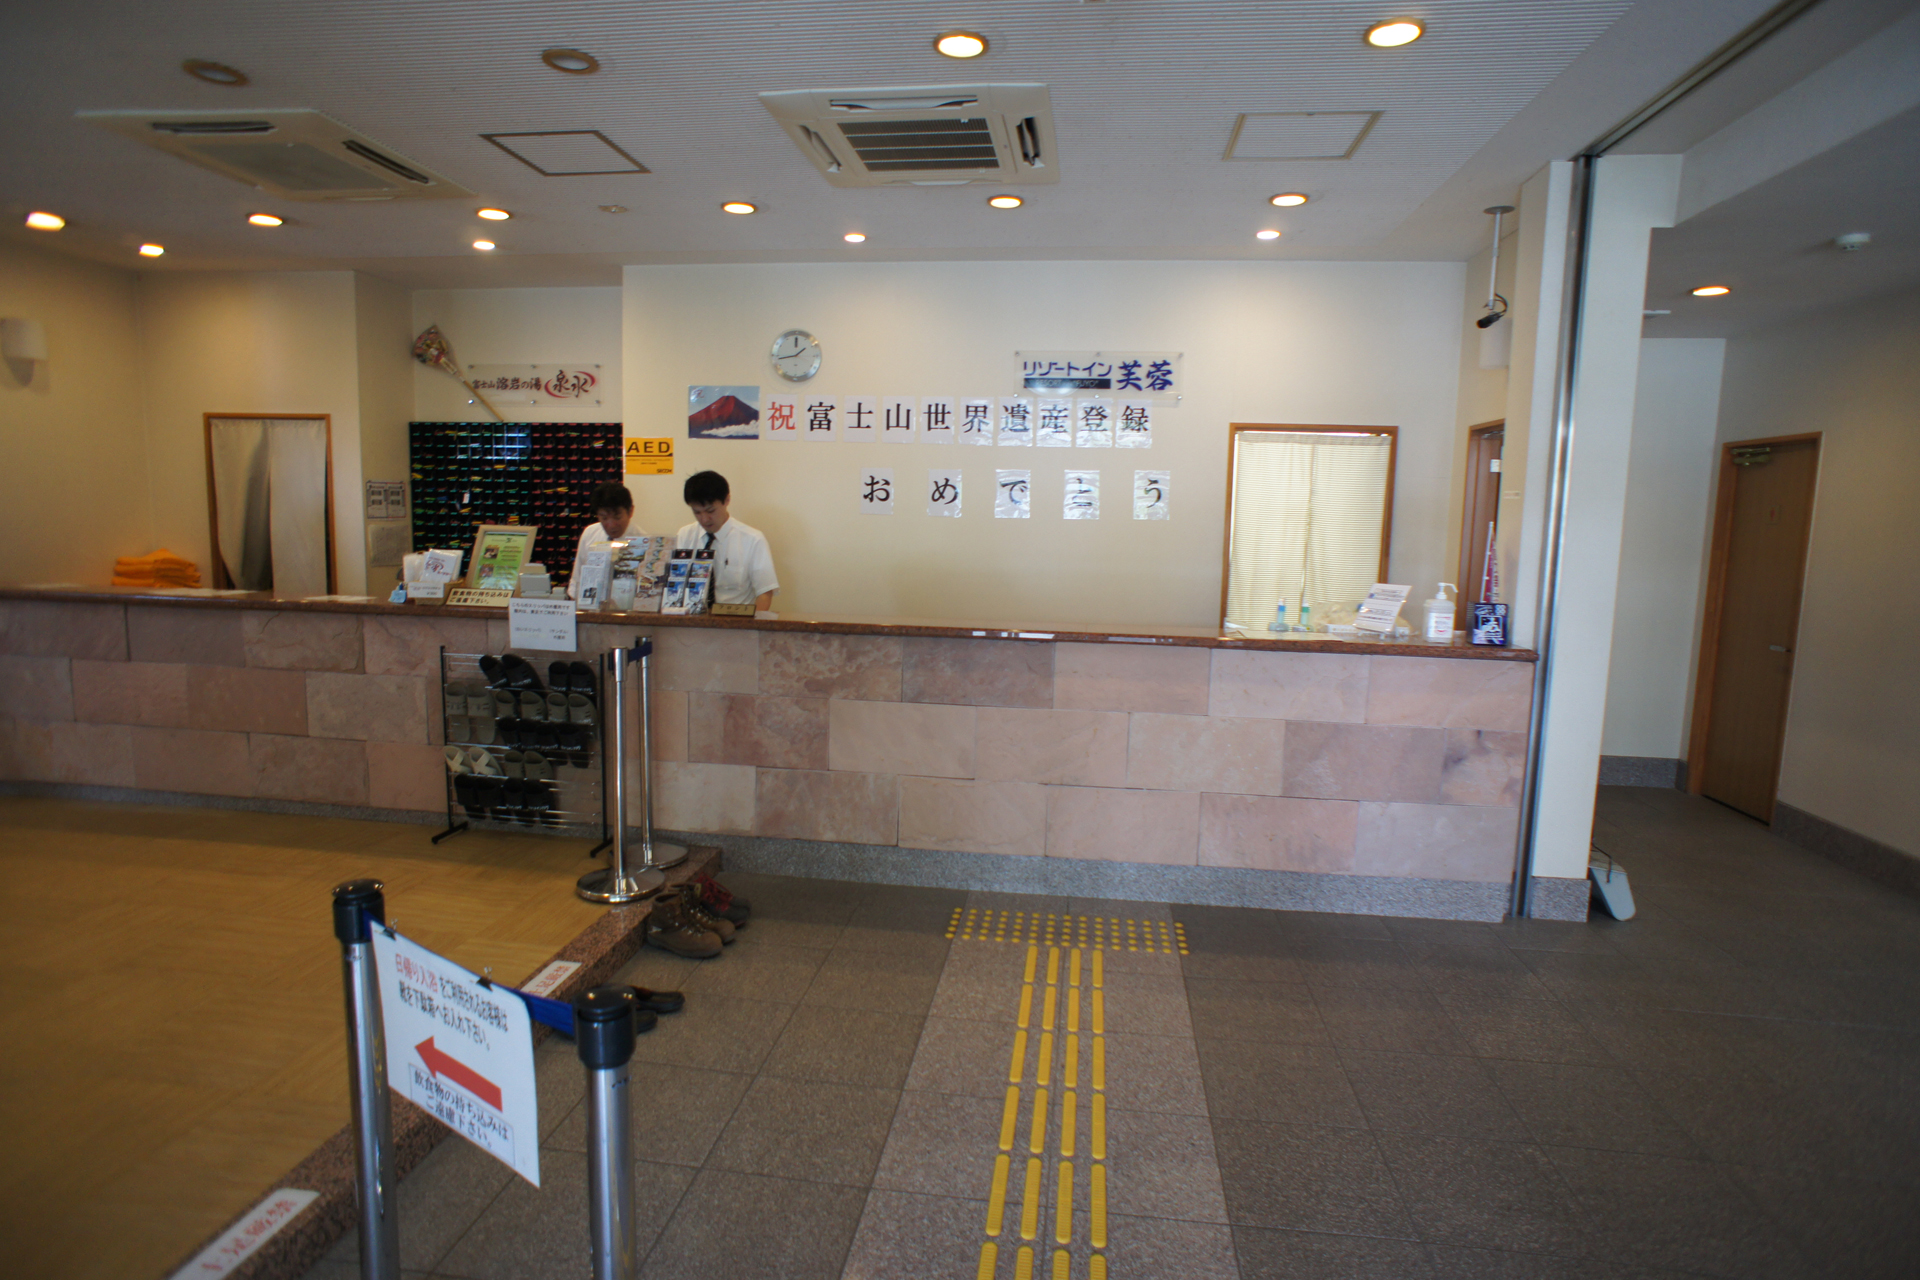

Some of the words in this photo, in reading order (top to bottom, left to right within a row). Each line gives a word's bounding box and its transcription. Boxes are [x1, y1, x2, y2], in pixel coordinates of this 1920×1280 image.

[472, 376, 542, 390] 富士山溶岩の湯
[552, 369, 589, 398] 泉水
[1023, 361, 1112, 377] リゾートイン
[1116, 359, 1174, 391] 芙蓉
[626, 441, 670, 454] AED
[414, 1069, 509, 1141] 飲食物の持ち込みは
[426, 1093, 492, 1149] ご遠慮下さい。
